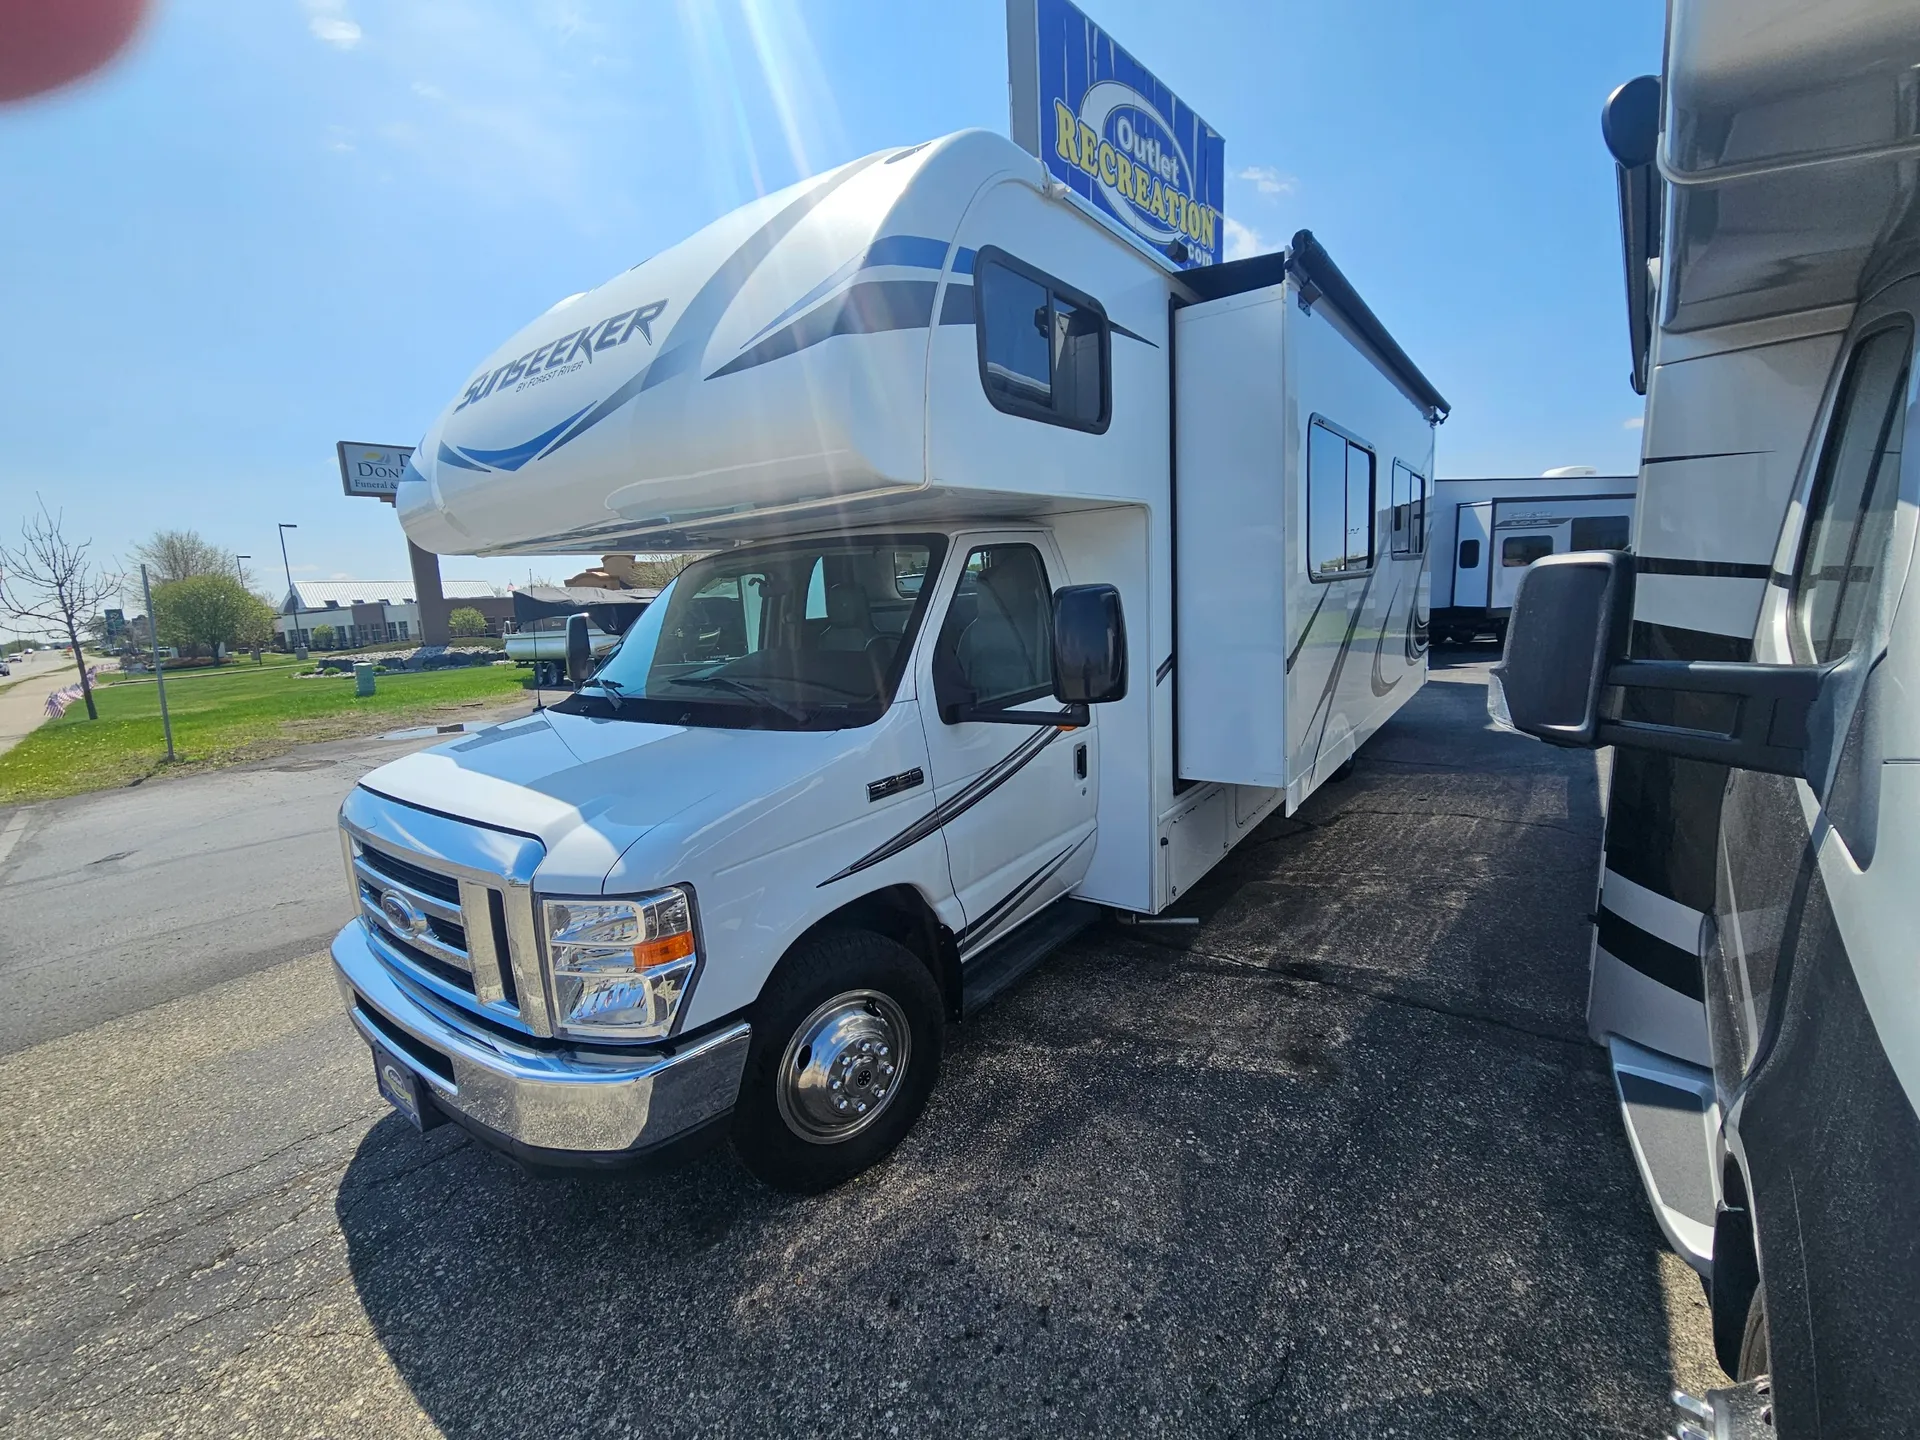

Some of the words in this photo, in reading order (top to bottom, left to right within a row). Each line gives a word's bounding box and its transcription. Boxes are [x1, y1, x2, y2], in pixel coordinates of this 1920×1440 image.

[1054, 97, 1216, 252] RECREATION
[1117, 115, 1180, 187] Outlet
[452, 298, 669, 415] SUNSEEKER
[515, 381, 529, 393] BY
[527, 370, 559, 389] FOREST
[557, 360, 584, 377] RIVER
[354, 479, 388, 490] Funeral
[389, 482, 398, 490] &
